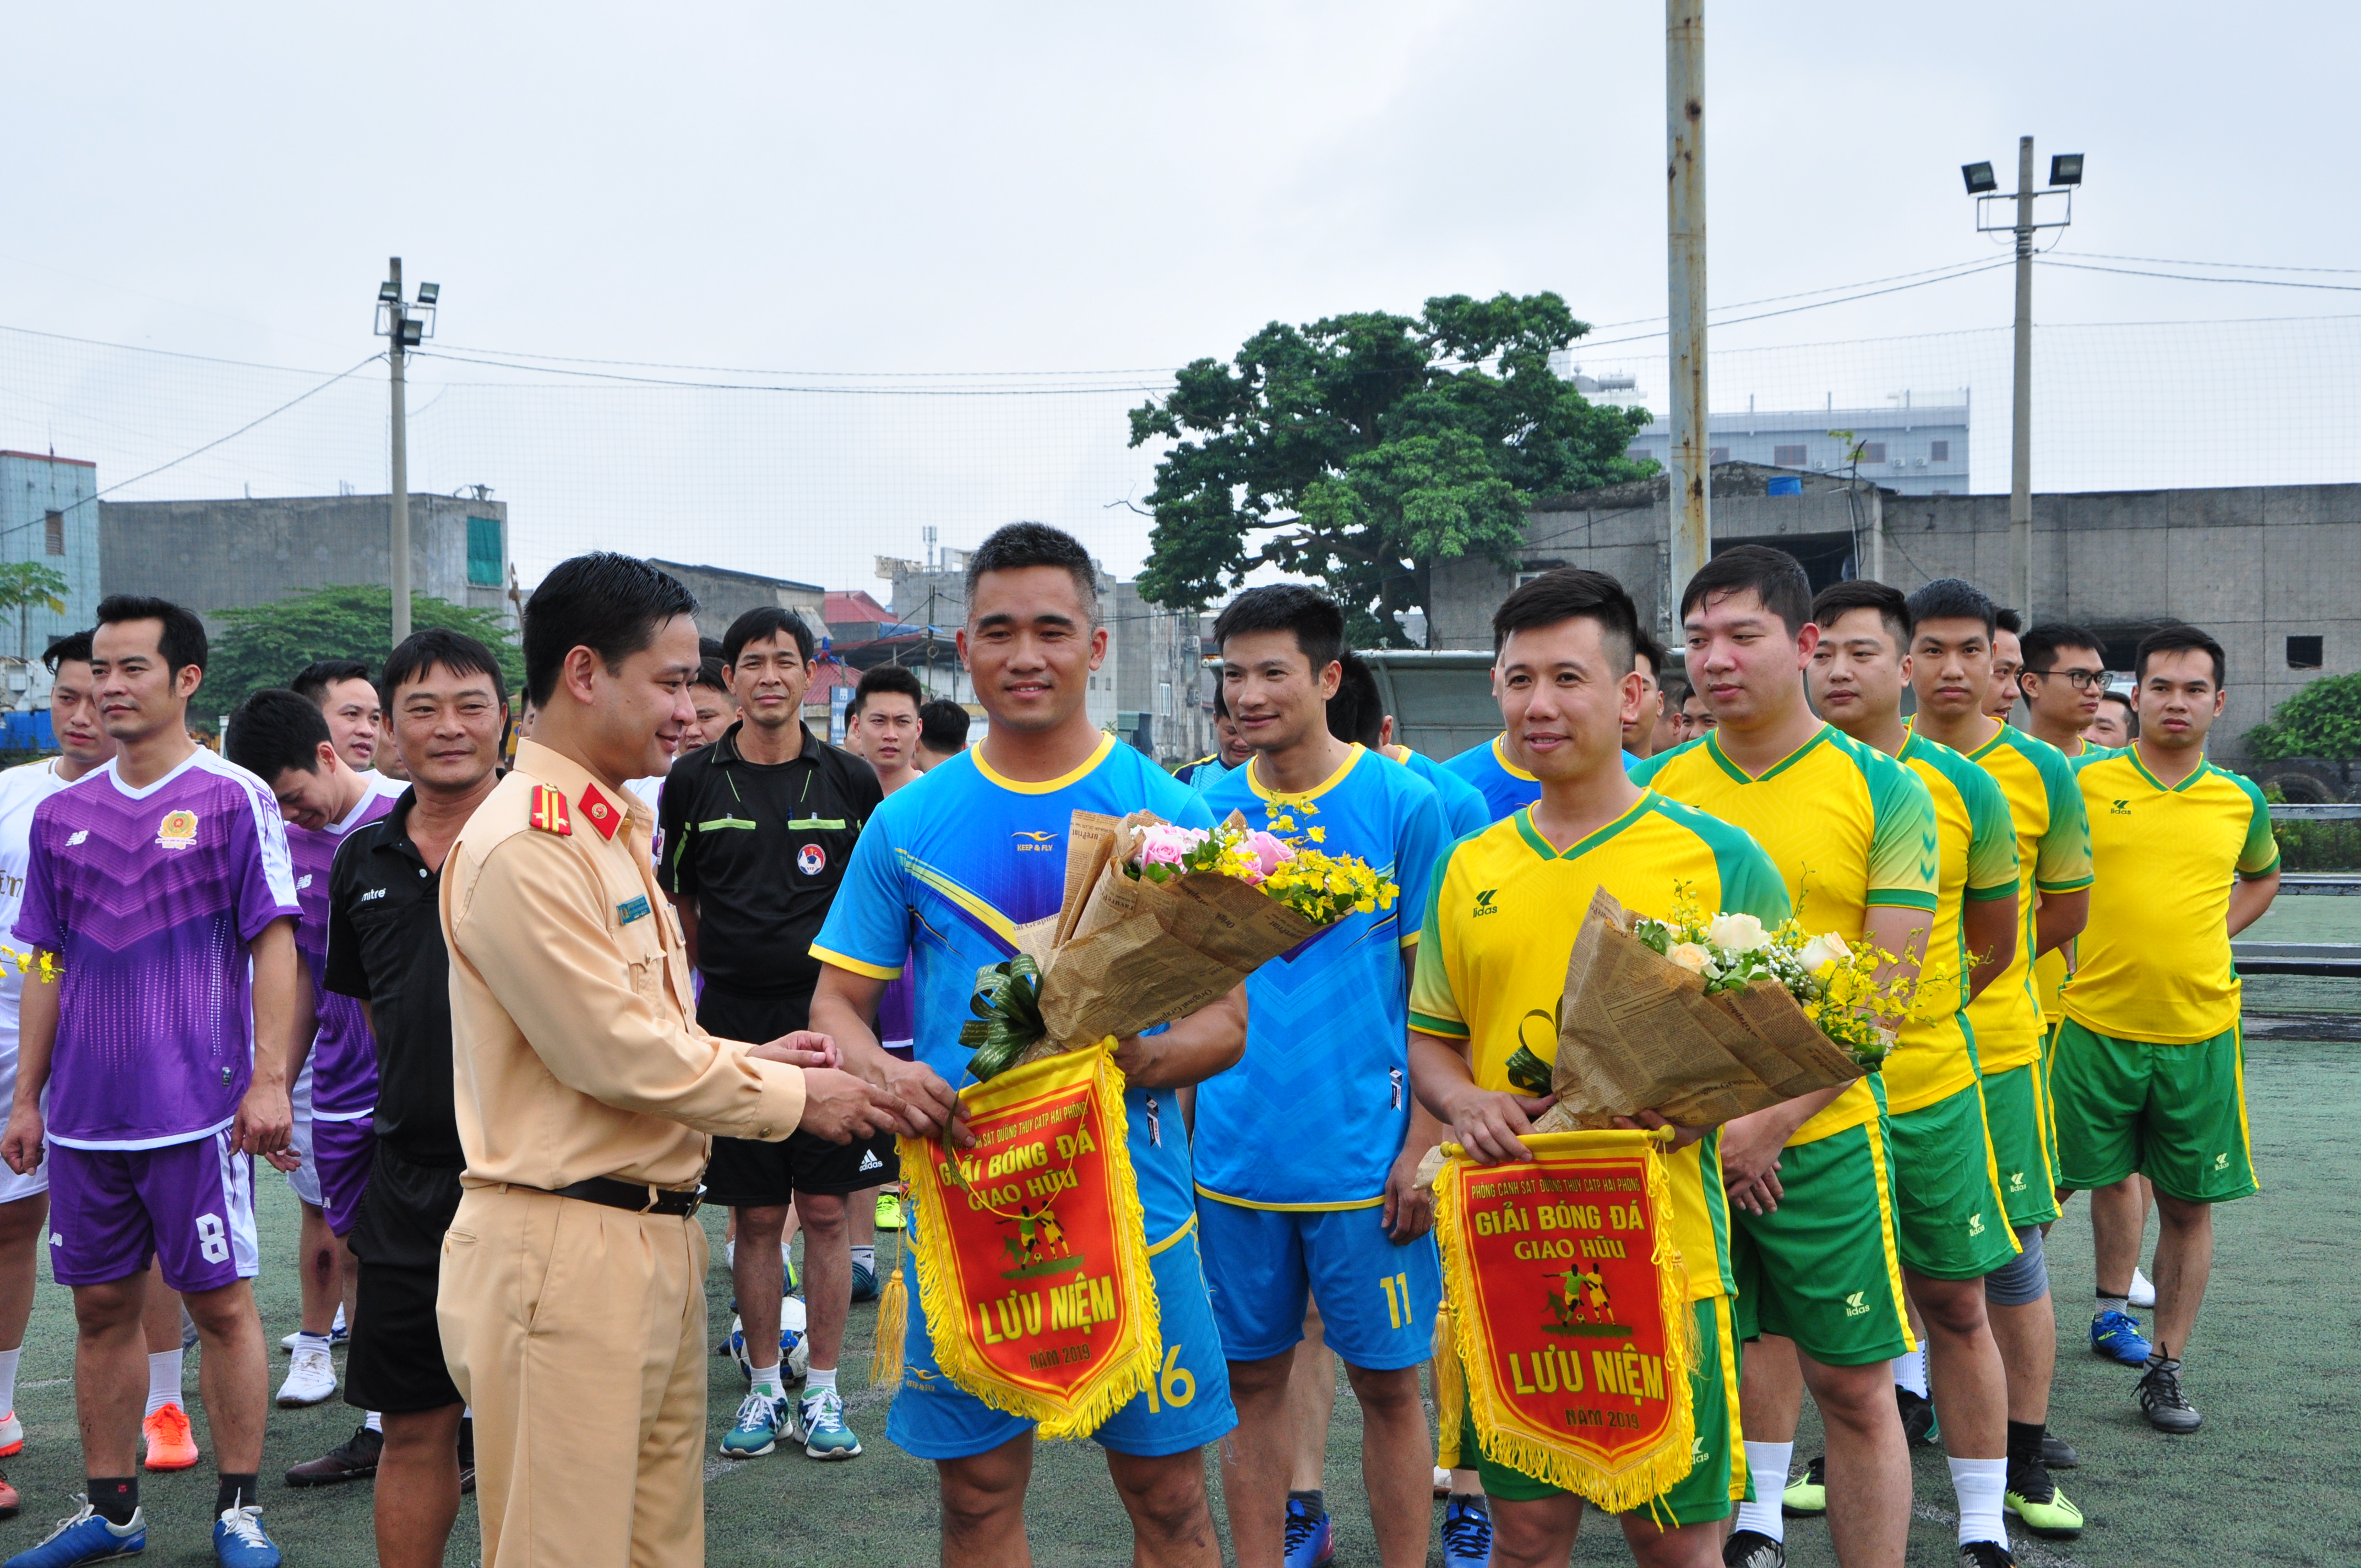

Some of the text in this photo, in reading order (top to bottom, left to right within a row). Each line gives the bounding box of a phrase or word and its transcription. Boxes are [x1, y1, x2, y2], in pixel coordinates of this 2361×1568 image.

[361, 889, 385, 901] mitre
[1473, 906, 1498, 918] lidas
[983, 1129, 995, 1147] SÁT
[1034, 1115, 1049, 1130] CATP
[1051, 1104, 1063, 1125] HẢI
[1063, 1101, 1089, 1121] PHÒNG
[988, 1141, 1049, 1179] BÓNG
[1055, 1123, 1097, 1160] ĐÁ
[859, 1161, 883, 1172] adidas
[2215, 1162, 2229, 1170] lidas
[967, 1168, 1079, 1211] GIAO HỮU
[1471, 1181, 1496, 1199] PHÒNG
[1497, 1177, 1520, 1196] CẢNH
[1521, 1177, 1537, 1194] SÁT
[1584, 1179, 1601, 1193] CATP
[1603, 1174, 1616, 1192] HẢI
[1617, 1175, 1640, 1192] PHÒNG
[2010, 1183, 2027, 1193] lidas
[1475, 1200, 1645, 1236] GIẢI BÓNG ĐÁ
[1970, 1224, 1985, 1237] lidas
[195, 1212, 230, 1265] 8
[1514, 1235, 1627, 1260] GIAO HỮU
[978, 1271, 1117, 1345] LƯU NIỆM
[1380, 1272, 1413, 1329] 11
[1846, 1305, 1870, 1317] lidas
[1029, 1342, 1091, 1371] NĂM 2019
[1508, 1342, 1666, 1407] LƯU NIỆM
[1564, 1405, 1640, 1430] NĂM 2019
